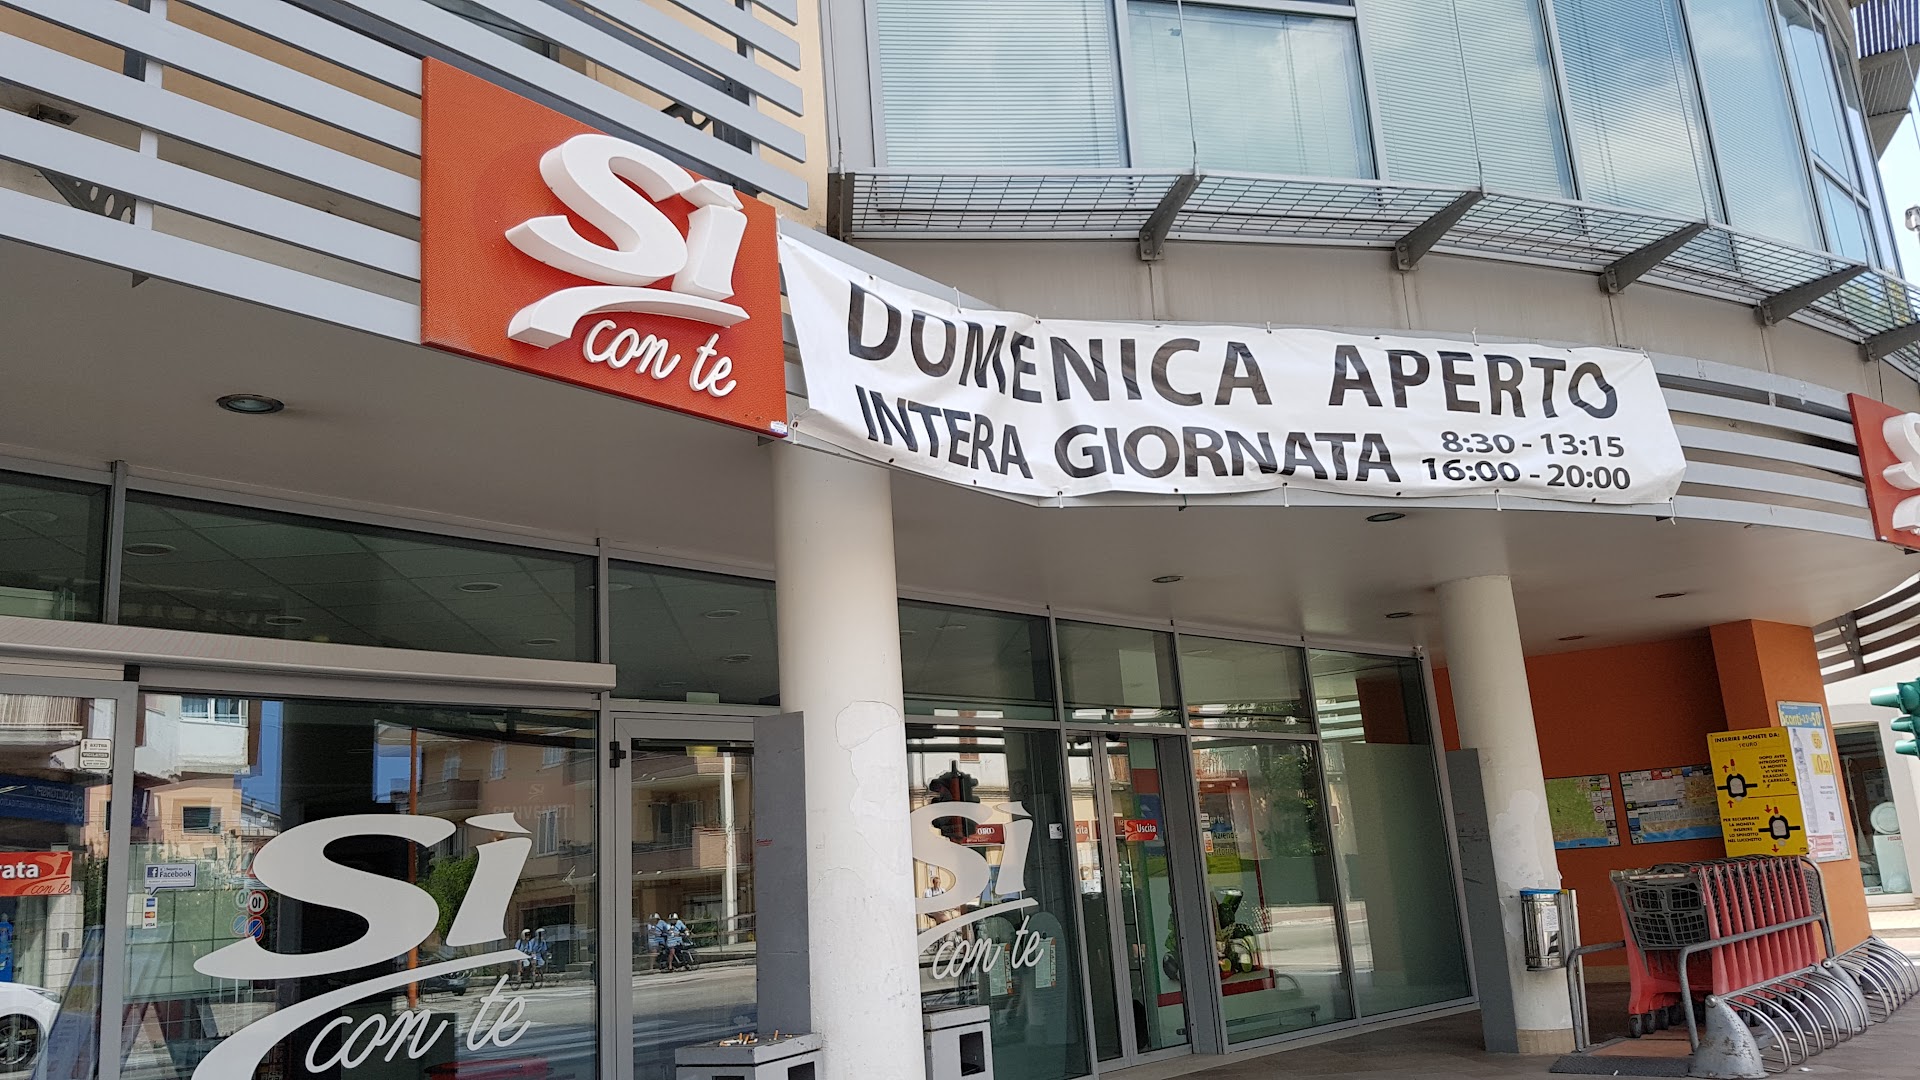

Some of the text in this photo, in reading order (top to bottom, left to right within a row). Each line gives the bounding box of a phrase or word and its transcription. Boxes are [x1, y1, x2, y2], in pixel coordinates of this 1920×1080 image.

[582, 319, 737, 398] con te
[848, 280, 1618, 419] DOMENICA APERTO
[855, 384, 1402, 483] INTERA GIORNATA
[1440, 431, 1515, 455] 8:30
[1540, 433, 1625, 458] 13:15
[1421, 457, 1521, 482] 16:00
[1546, 463, 1631, 490] 20:00
[1714, 735, 1740, 743] INSERIRE
[1742, 733, 1767, 741] MONETE
[1136, 823, 1157, 833] Uscita
[160, 870, 192, 878] Facebook
[932, 937, 1002, 980] con
[1011, 914, 1044, 969] te
[304, 974, 531, 1074] con te
